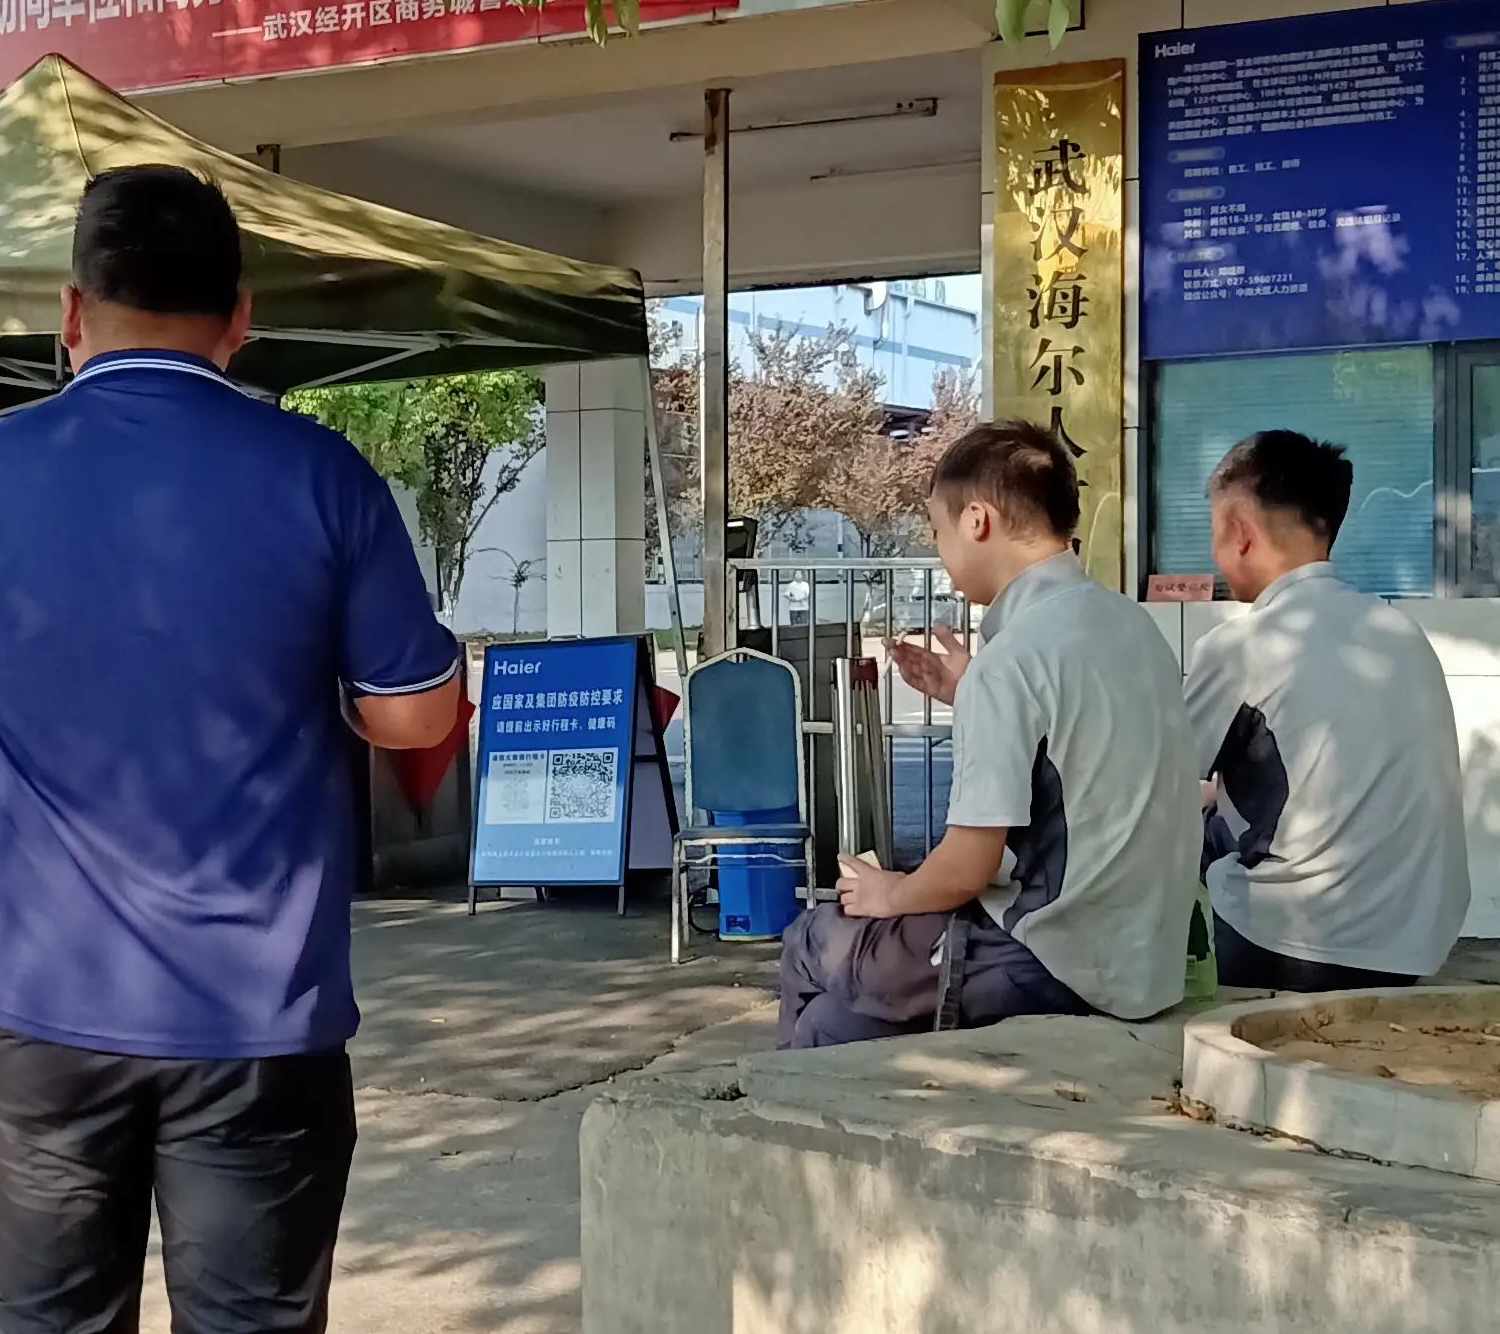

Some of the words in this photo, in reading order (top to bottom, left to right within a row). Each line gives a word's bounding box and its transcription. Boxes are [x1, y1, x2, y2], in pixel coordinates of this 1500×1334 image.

[1154, 41, 1196, 59] Haier
[493, 659, 542, 676] Haier
[491, 688, 624, 710] 应国家及集团防疫防控要求
